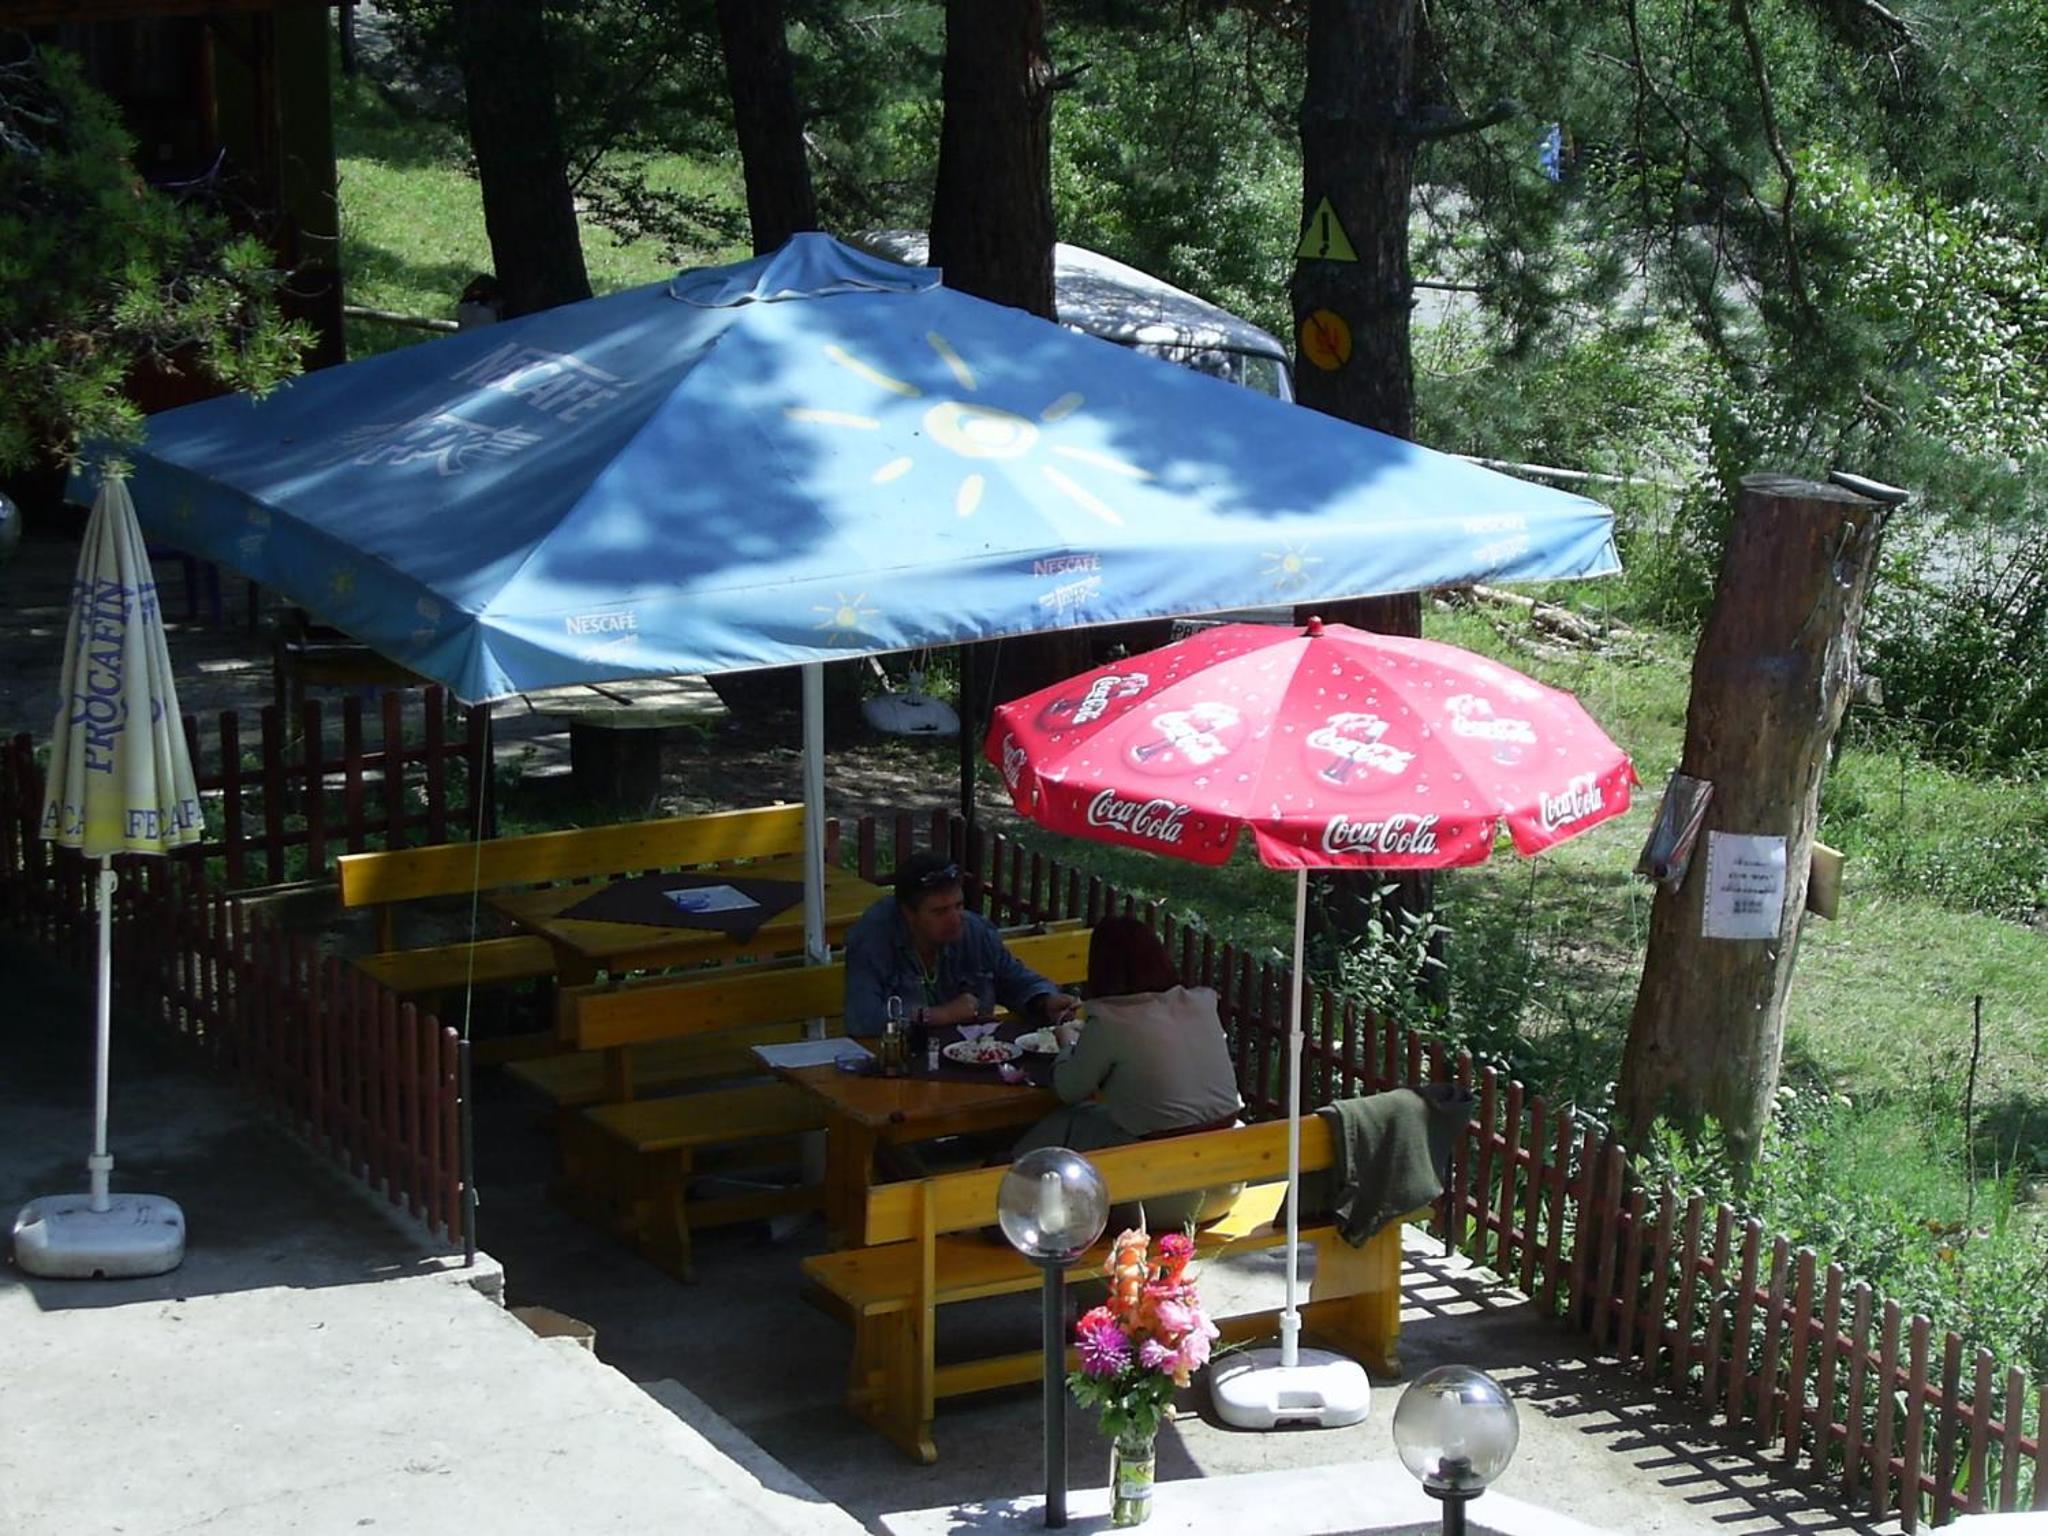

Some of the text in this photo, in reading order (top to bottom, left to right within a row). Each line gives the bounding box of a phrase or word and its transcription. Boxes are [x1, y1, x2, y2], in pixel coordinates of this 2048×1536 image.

[1088, 788, 1191, 843] Coca-Cola
[1539, 772, 1604, 832] Coca-Cola
[1321, 813, 1439, 855] Coca-Cola
